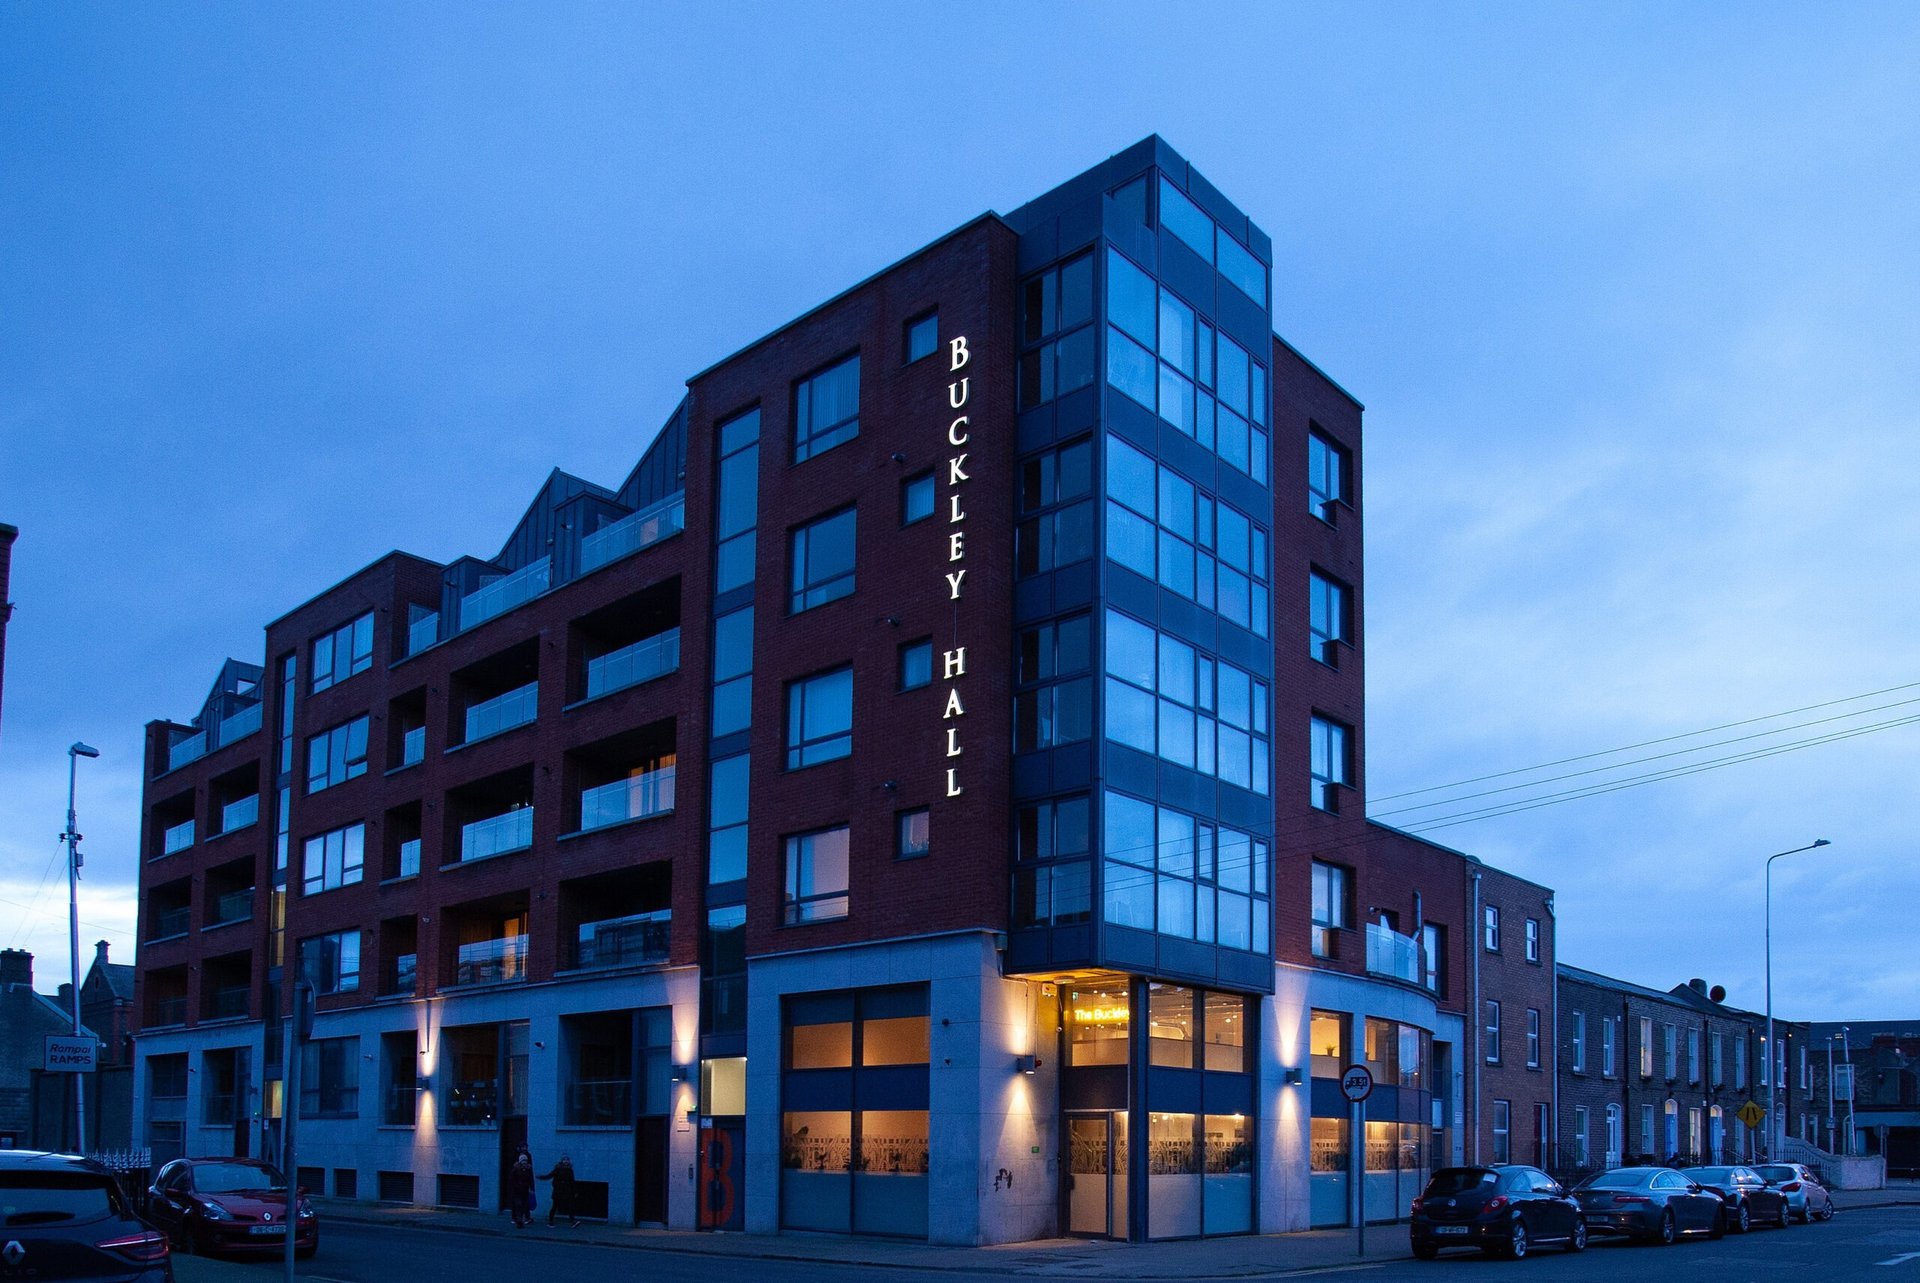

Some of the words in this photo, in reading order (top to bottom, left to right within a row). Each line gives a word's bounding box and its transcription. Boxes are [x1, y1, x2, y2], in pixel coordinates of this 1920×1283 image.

[945, 335, 969, 600] BUCKLEY
[942, 646, 966, 798] HALL
[1074, 1009, 1092, 1021] The
[50, 1054, 92, 1065] RAMPS
